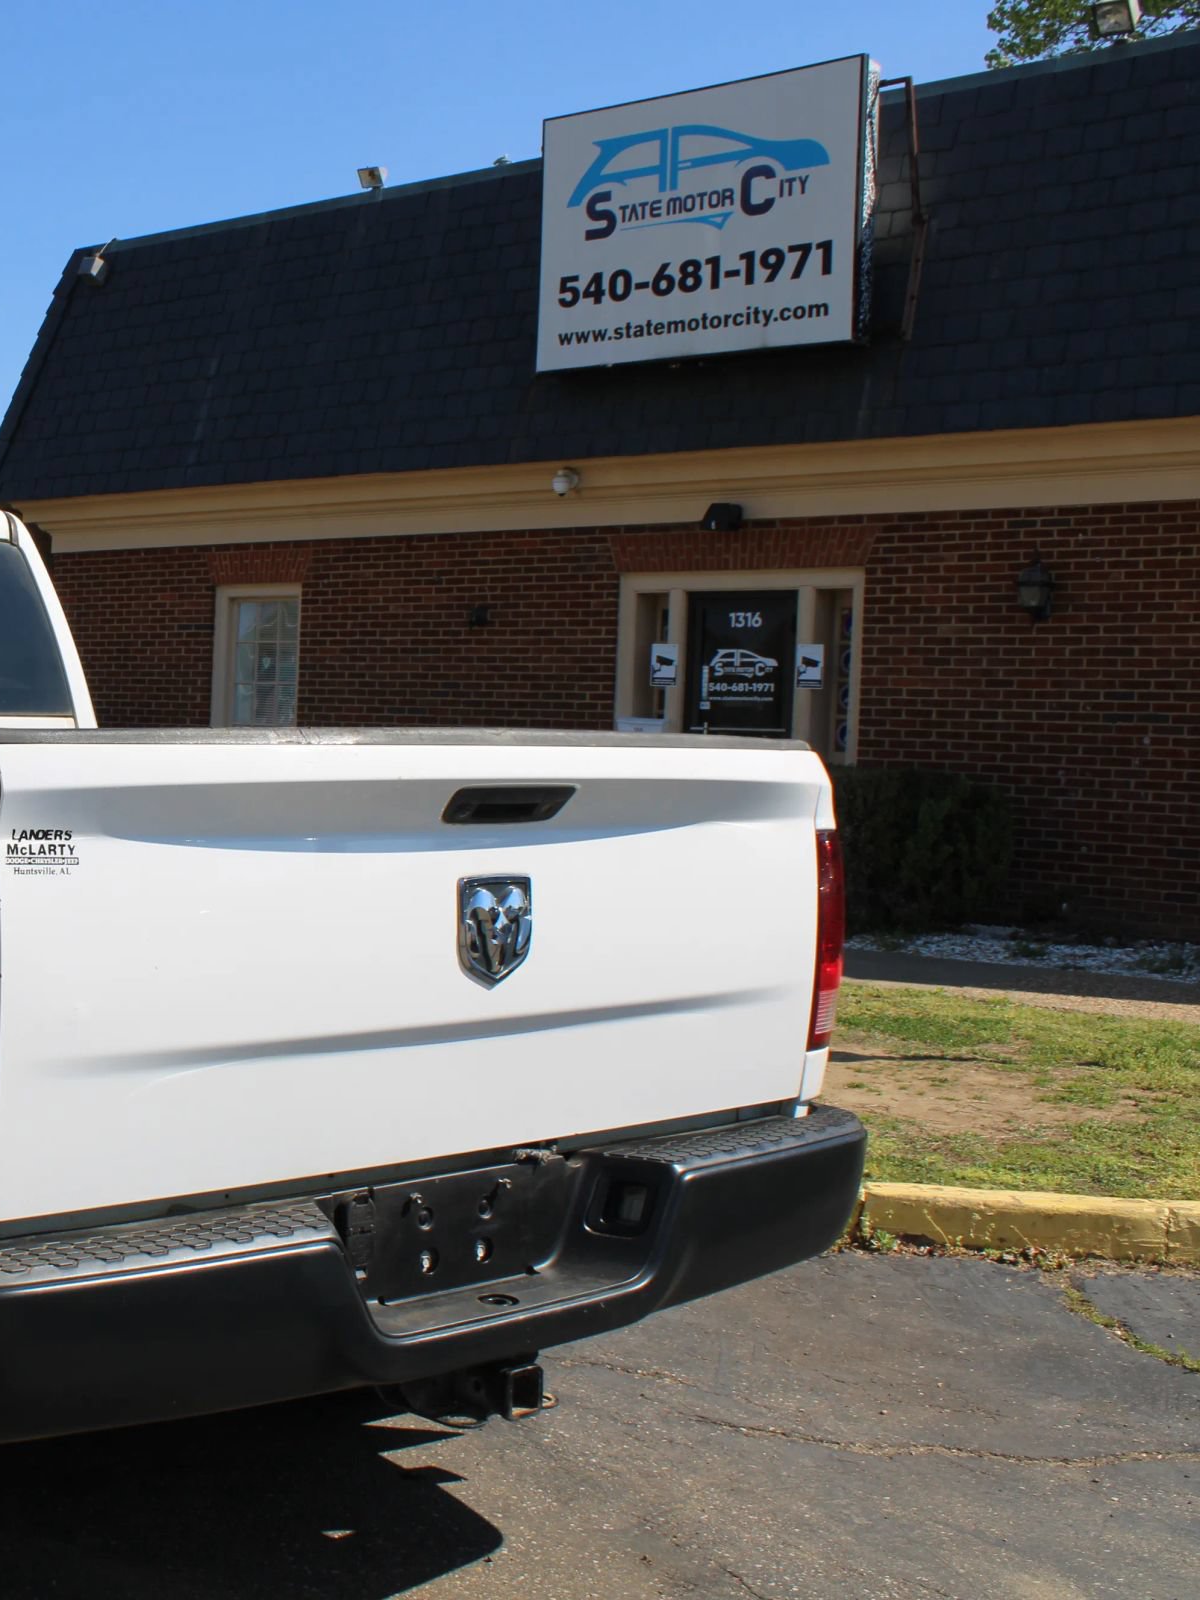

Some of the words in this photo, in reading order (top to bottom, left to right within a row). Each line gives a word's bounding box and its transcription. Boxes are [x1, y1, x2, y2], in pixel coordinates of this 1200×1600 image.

[666, 188, 735, 216] MOTOR
[558, 240, 833, 309] 540-681-1971
[558, 303, 830, 346] www.statemotorcity.com
[729, 612, 762, 628] 1316
[708, 682, 775, 693] 540-681-1971
[11, 828, 72, 842] LANDERS
[7, 844, 75, 855] McLARTY
